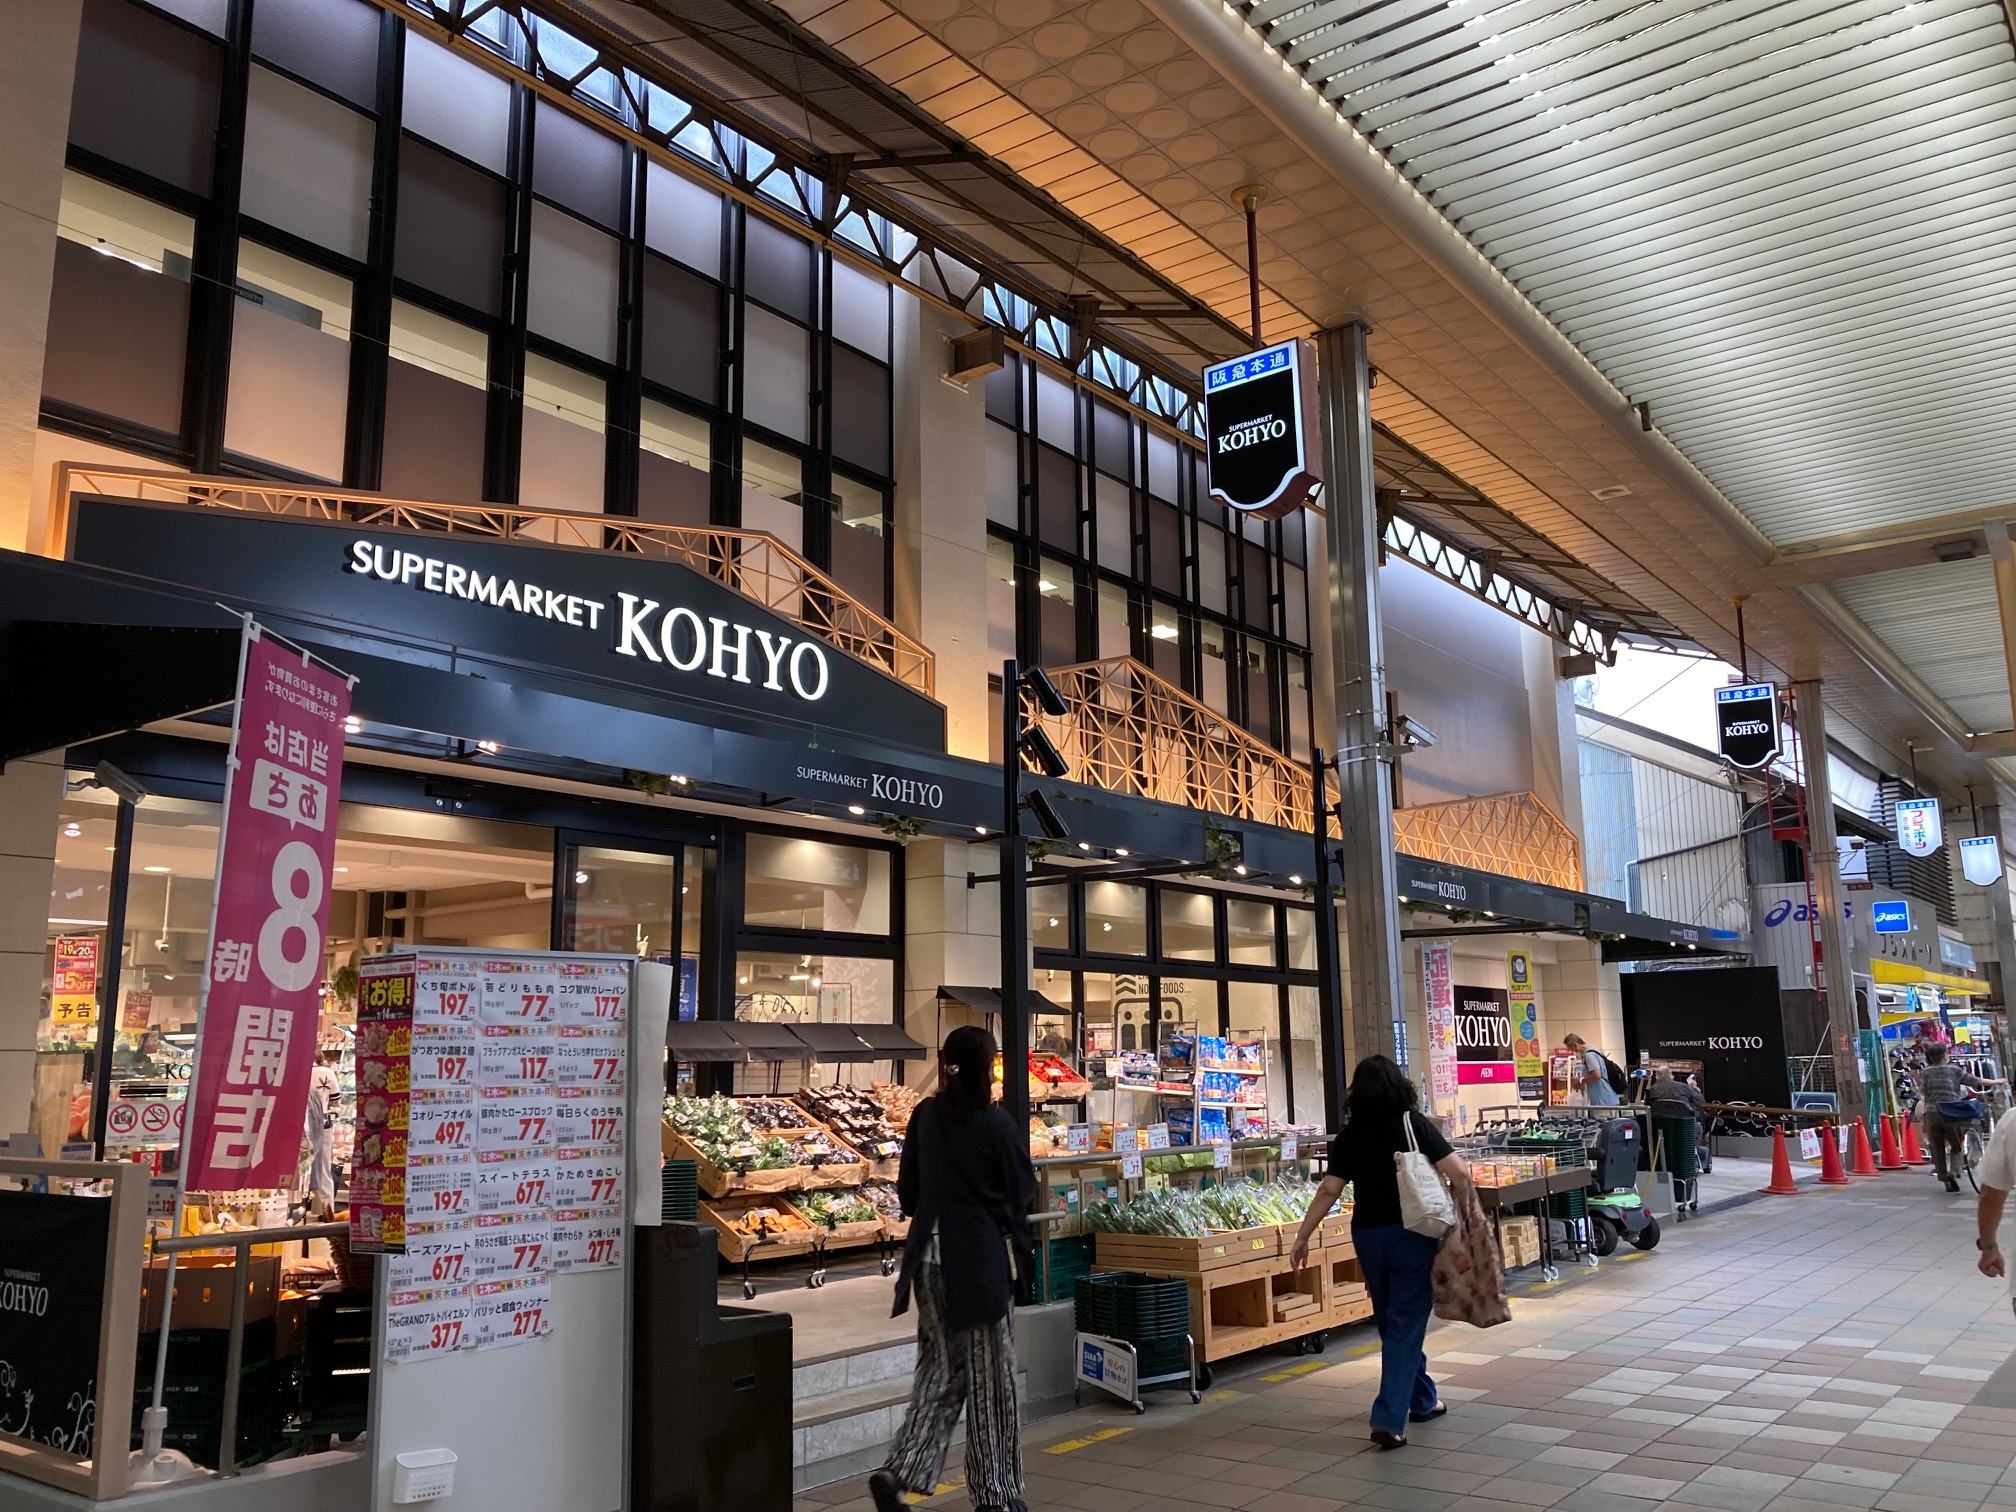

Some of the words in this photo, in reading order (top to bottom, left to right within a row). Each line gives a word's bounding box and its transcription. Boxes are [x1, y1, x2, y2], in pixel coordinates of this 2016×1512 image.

[1212, 352, 1285, 387] 阪急本通
[1229, 414, 1273, 433] SUPERMARKET
[1218, 419, 1286, 454] KOHYO
[350, 540, 604, 631] SUPERMARKET
[615, 591, 829, 701] KOHYO
[1721, 688, 1768, 700] 阪急本通
[1725, 723, 1768, 736] KOHYO
[797, 766, 868, 789] SUPERMARKET
[871, 773, 943, 809] KOHYO
[1411, 880, 1438, 891] SUPERMARKET
[1438, 881, 1466, 901] KOHYO
[486, 982, 554, 994] 若どりもも肉
[560, 985, 627, 995] コク旨Wカレーパン
[58, 1002, 92, 1019] 予告
[1463, 1000, 1500, 1012] SUPERMARKET
[1455, 1015, 1511, 1048] KOHYO
[1708, 1036, 1763, 1049] KOHYO
[412, 1109, 473, 1121] コオリーブオイル
[481, 1107, 552, 1119] 豚肉かたロースブロック
[556, 1107, 623, 1118] 毎日らくのう牛乳
[479, 1169, 550, 1183] スイートテラス
[556, 1167, 622, 1180] かためきぬこし
[474, 1297, 549, 1317] パリッと朝食ウィンナー
[389, 1308, 470, 1328] TheGRANDアルトバイエルン
